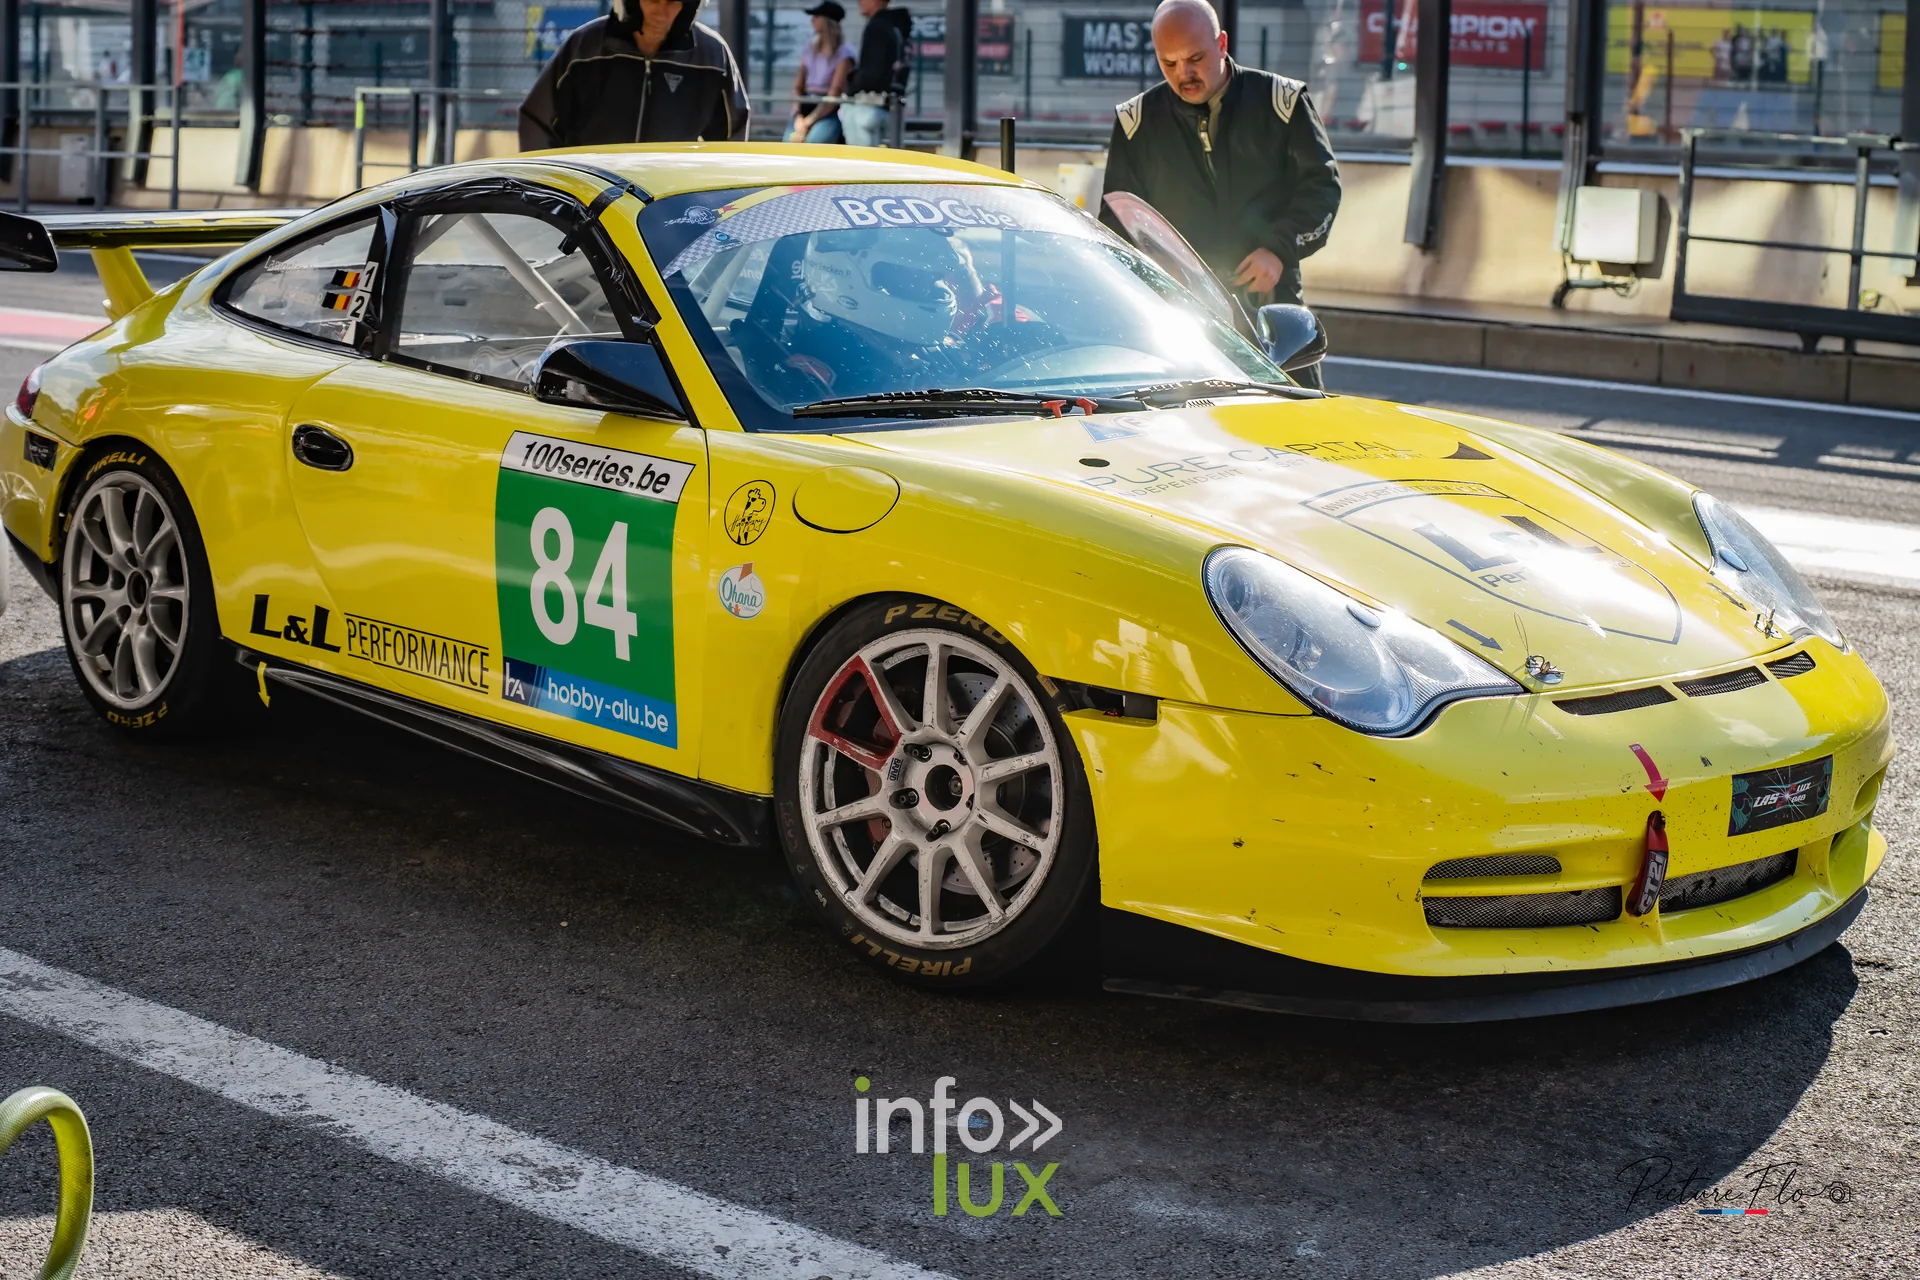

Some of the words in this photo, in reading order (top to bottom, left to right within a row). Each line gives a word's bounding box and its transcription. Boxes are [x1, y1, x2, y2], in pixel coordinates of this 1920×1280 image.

[838, 199, 1016, 228] BGDC.be
[363, 266, 375, 288] 1
[350, 295, 365, 319] 2
[85, 451, 147, 481] PIRELLI
[520, 441, 671, 494] 100series.be
[1080, 455, 1229, 491] PURE
[1228, 441, 1413, 463] CAPITAL
[1117, 468, 1244, 498] NDEPENDENT
[530, 507, 638, 662] 84
[722, 577, 762, 608] Ohana
[249, 594, 341, 653] L&L
[346, 618, 490, 690] PERFORMANCE
[548, 677, 669, 733] hobby-alu.be
[851, 933, 972, 977] PIRELLI
